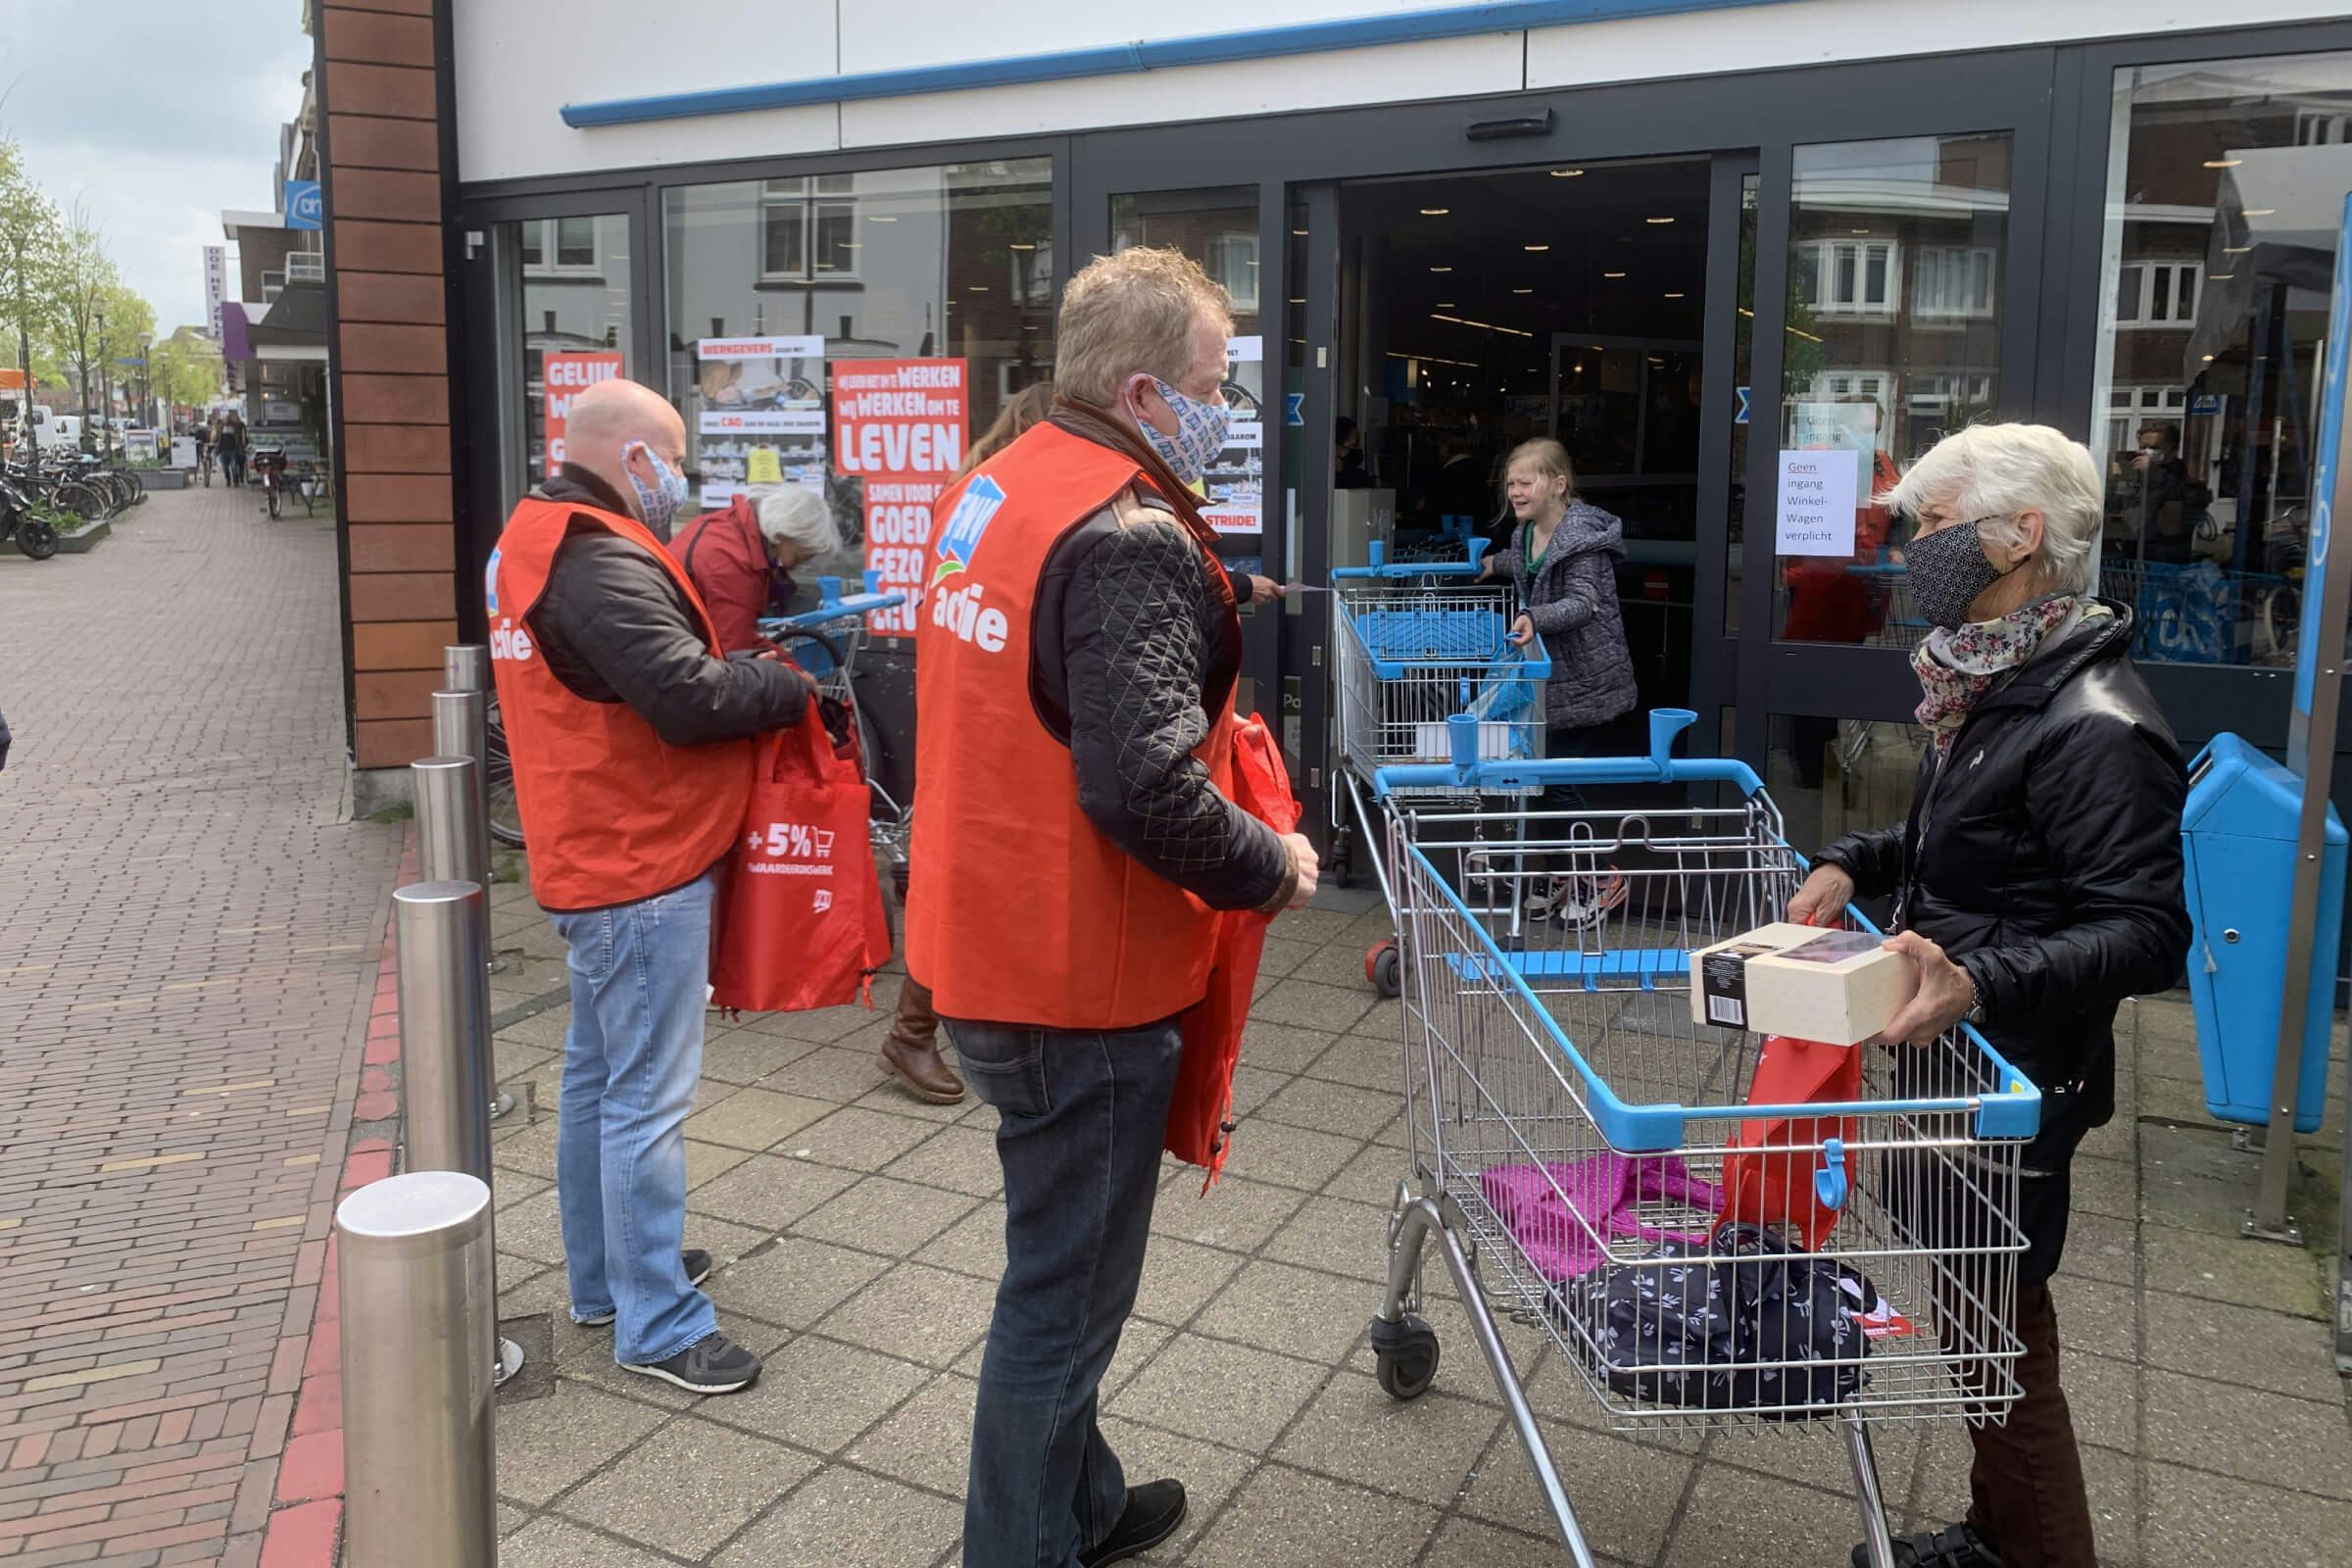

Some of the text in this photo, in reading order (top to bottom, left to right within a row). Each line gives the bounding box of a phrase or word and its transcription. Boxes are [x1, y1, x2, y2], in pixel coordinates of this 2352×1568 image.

[549, 362, 619, 386] GELIJK
[897, 366, 960, 388] WERKEN
[857, 391, 926, 416] WERKEN
[927, 400, 945, 416] OM
[946, 399, 959, 416] TE
[841, 423, 960, 471] LEVEN
[1788, 462, 1817, 472] Geen
[1788, 478, 1824, 491] ingang
[1787, 496, 1828, 507] Winkel-
[1786, 514, 1824, 525] Wagen
[1785, 530, 1833, 542] verplicht
[933, 582, 1008, 654] actie
